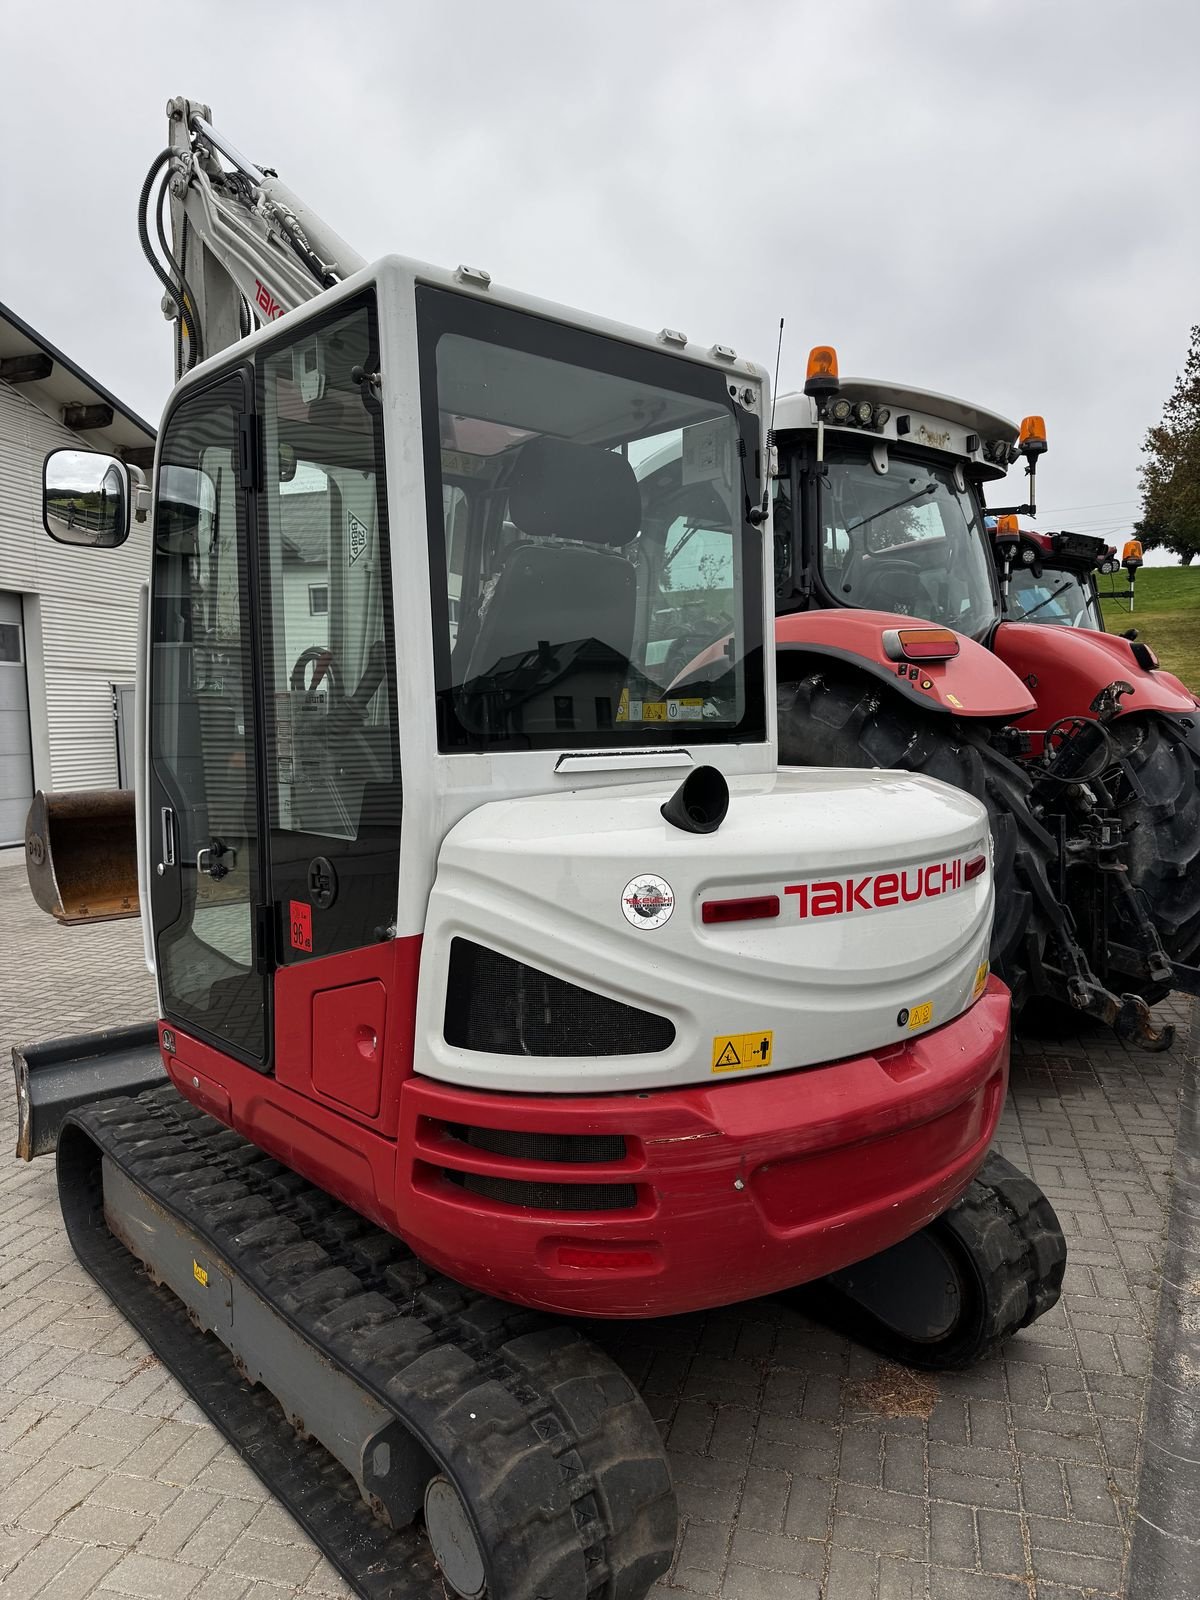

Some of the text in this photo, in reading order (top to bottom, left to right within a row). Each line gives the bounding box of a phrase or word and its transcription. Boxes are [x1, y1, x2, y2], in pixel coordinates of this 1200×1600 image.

[623, 896, 672, 905] TAKEUCHI
[784, 859, 961, 918] TAKEUCHI
[293, 921, 304, 946] 96
